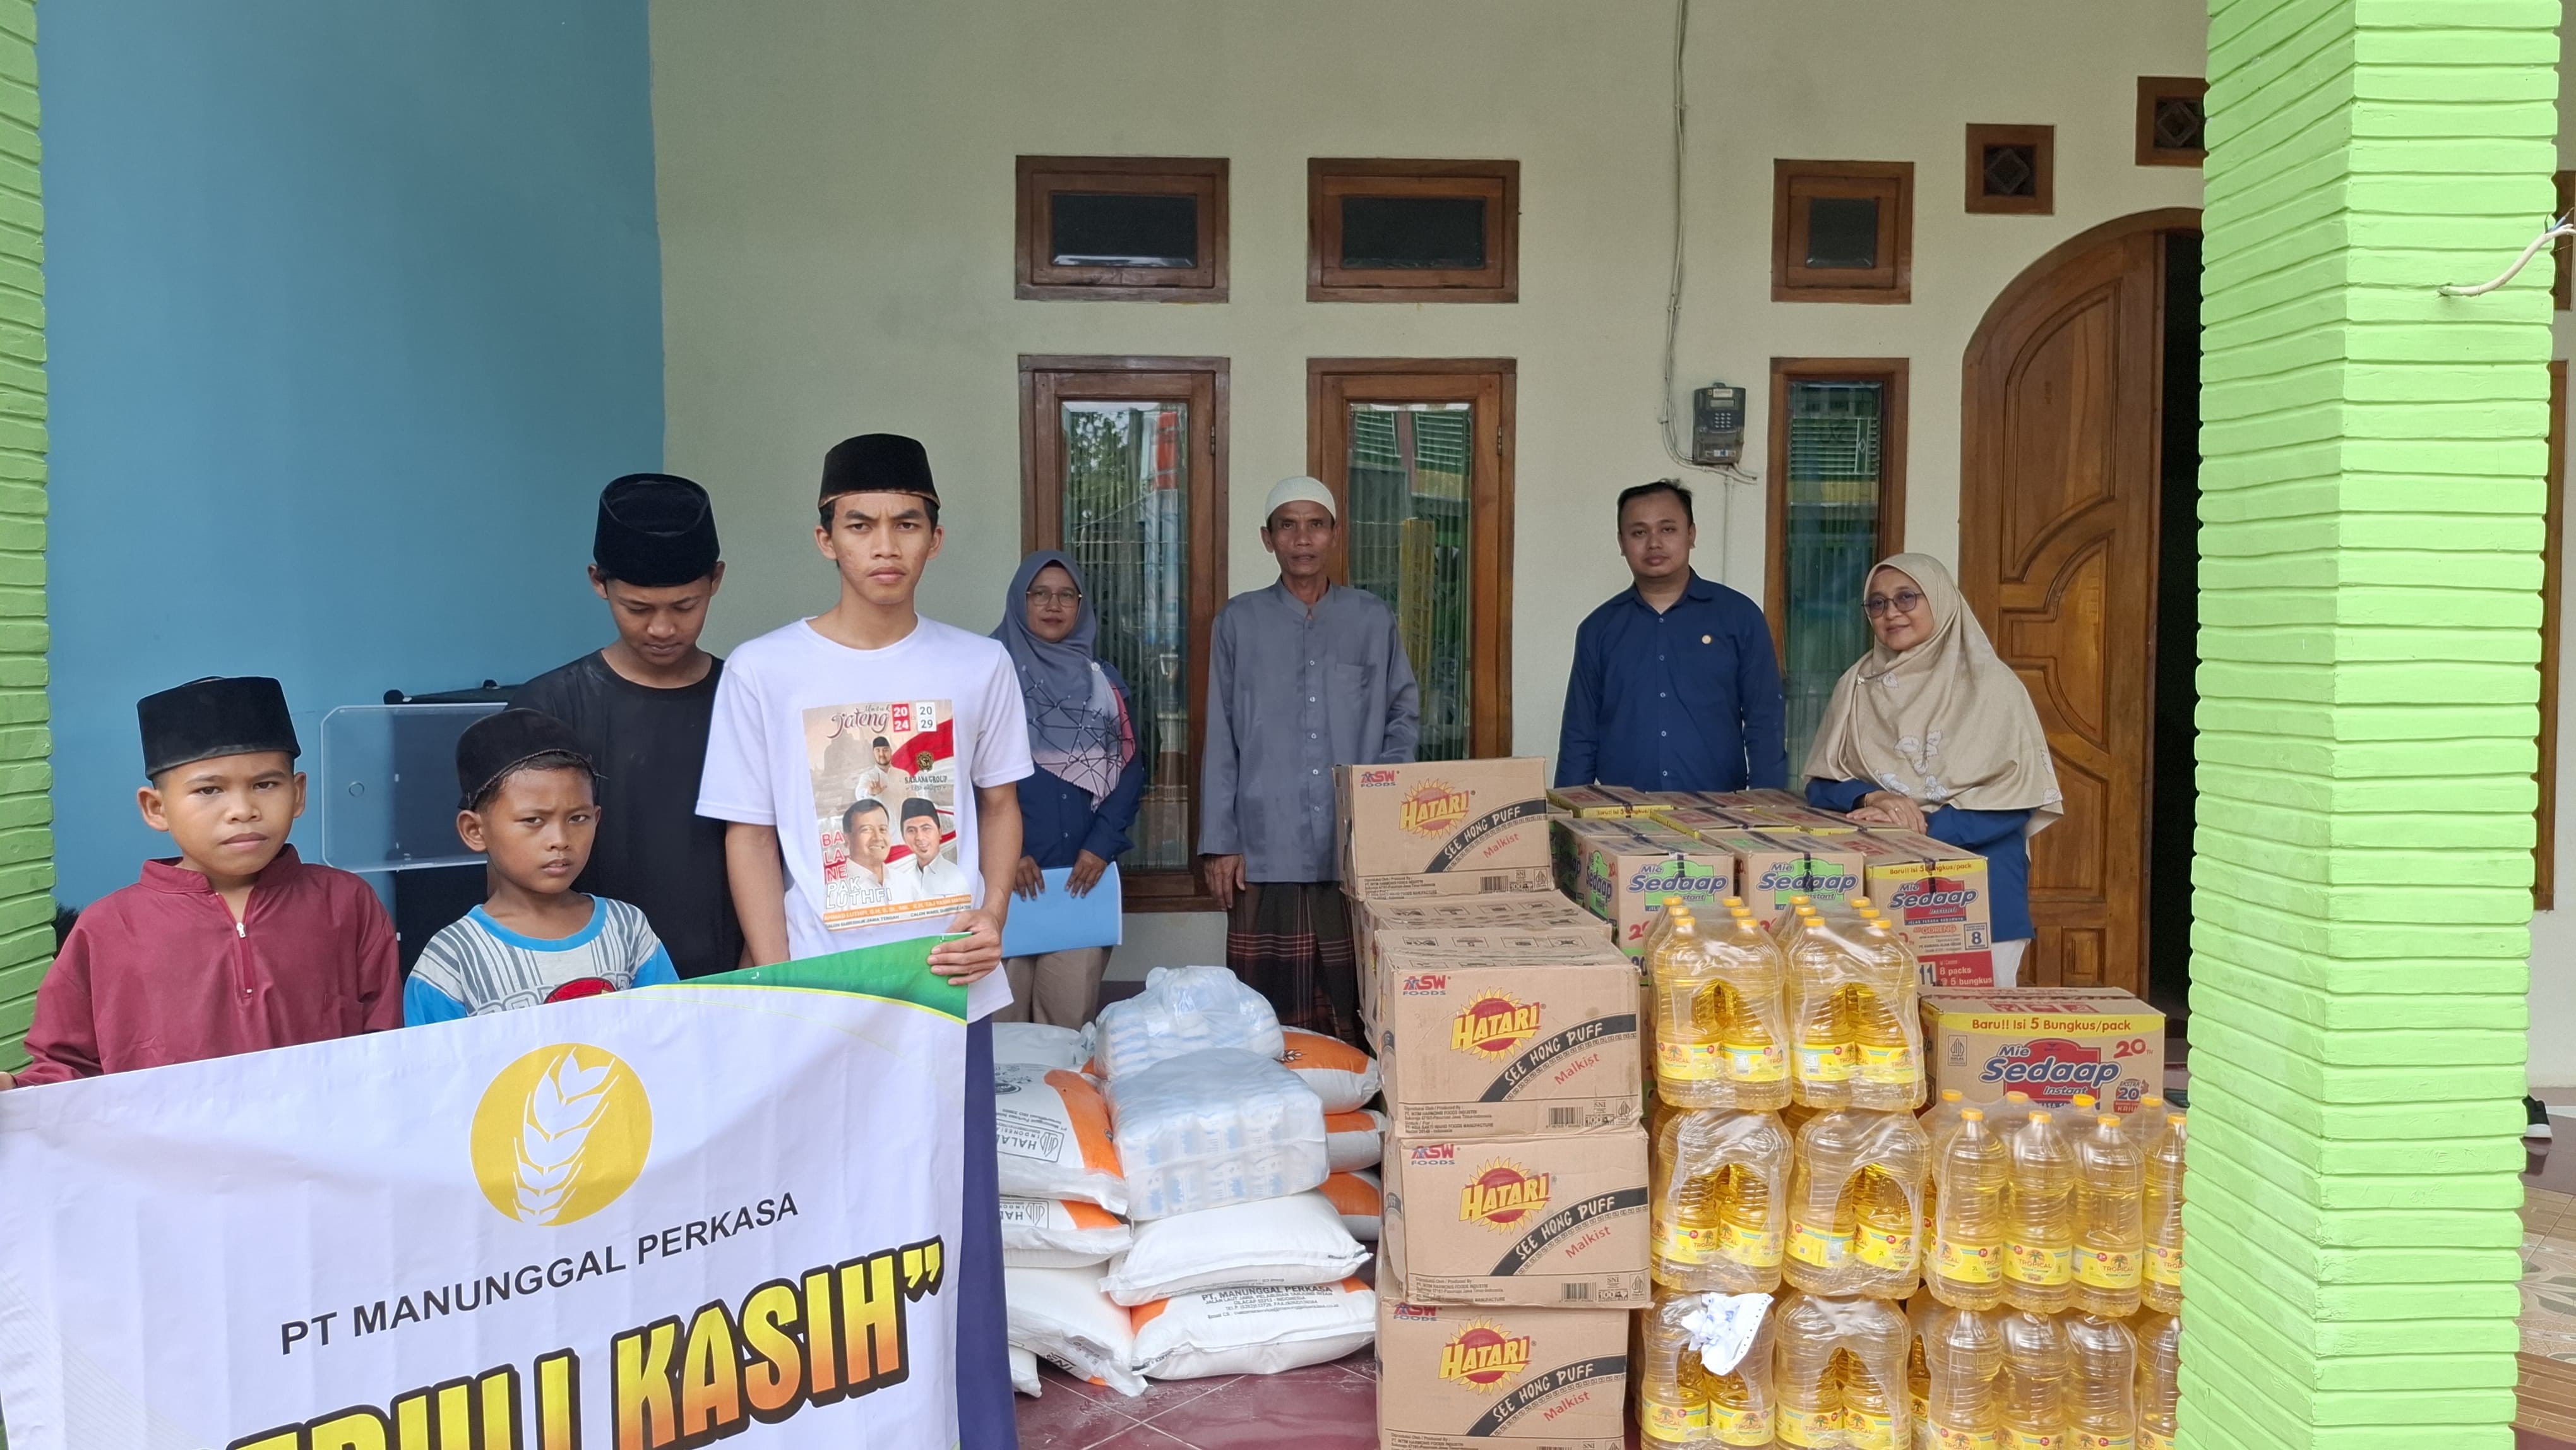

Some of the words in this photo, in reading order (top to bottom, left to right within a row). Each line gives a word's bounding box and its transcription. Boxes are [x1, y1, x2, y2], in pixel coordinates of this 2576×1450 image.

[893, 706, 909, 717] 20
[919, 706, 933, 716] 20
[895, 720, 909, 731] 24
[921, 719, 933, 729] 29
[1361, 770, 1395, 783] ASW
[1399, 790, 1470, 832] HATARI
[821, 830, 845, 848] BA
[1445, 840, 1462, 860] SEE
[1464, 819, 1488, 842] HONG
[1492, 806, 1521, 826] PUFF
[1483, 833, 1520, 860] Malkist
[823, 848, 846, 865] LA
[825, 863, 847, 883] NE
[1640, 863, 1664, 874] Mie
[1770, 862, 1794, 873] Mie
[826, 876, 861, 896] PAK
[1626, 873, 1729, 894] Sedaap
[1898, 882, 1920, 892] Mie
[825, 887, 892, 909] LUTHFI
[1887, 889, 1979, 910] Sedaap
[1921, 924, 1957, 934] GORENG
[1971, 932, 1982, 944] 8
[1940, 967, 1945, 975] 8
[1948, 966, 1972, 976] packs
[1404, 974, 1446, 990] ASW
[1959, 977, 1992, 986] bungkus
[1451, 1002, 1542, 1052] HATARI
[1972, 1019, 2010, 1030] Baru!!
[2013, 1019, 2026, 1030] Isi
[2030, 1017, 2039, 1030] 5
[2043, 1019, 2132, 1033] Bungkus/pack
[1505, 1062, 1527, 1087] SEE
[1530, 1040, 1561, 1062] HONG
[1567, 1022, 1603, 1046] PUFF
[1996, 1043, 2031, 1058] Mie
[2113, 1038, 2146, 1058] 20
[1554, 1052, 1600, 1086] Malkist
[1978, 1055, 2122, 1088] Sedaap
[2042, 1086, 2088, 1096] Instant
[2118, 1087, 2140, 1100] 20
[1411, 1144, 1454, 1159] ASW
[1458, 1173, 1551, 1223] HATARI
[1515, 1238, 1539, 1261] SEE
[1541, 1211, 1573, 1240] HONG
[1578, 1195, 1615, 1221] PUFF
[1565, 1226, 1611, 1259] Malkist
[2019, 1259, 2052, 1269] TROPICAL
[281, 1312, 338, 1356] PT
[353, 1245, 626, 1338] MANUNGGAL
[638, 1192, 799, 1266] PERKASA
[1202, 1293, 1216, 1301] PT.
[1219, 1285, 1284, 1298] MANUNGGAL
[1284, 1285, 1333, 1293] PERKASA
[1393, 1302, 1437, 1317] ASW
[1438, 1336, 1532, 1382] HATARI
[1493, 1401, 1516, 1423] SEE
[1519, 1378, 1551, 1404] HONG
[1556, 1363, 1594, 1386] PUFF
[1543, 1391, 1592, 1422] Malkist
